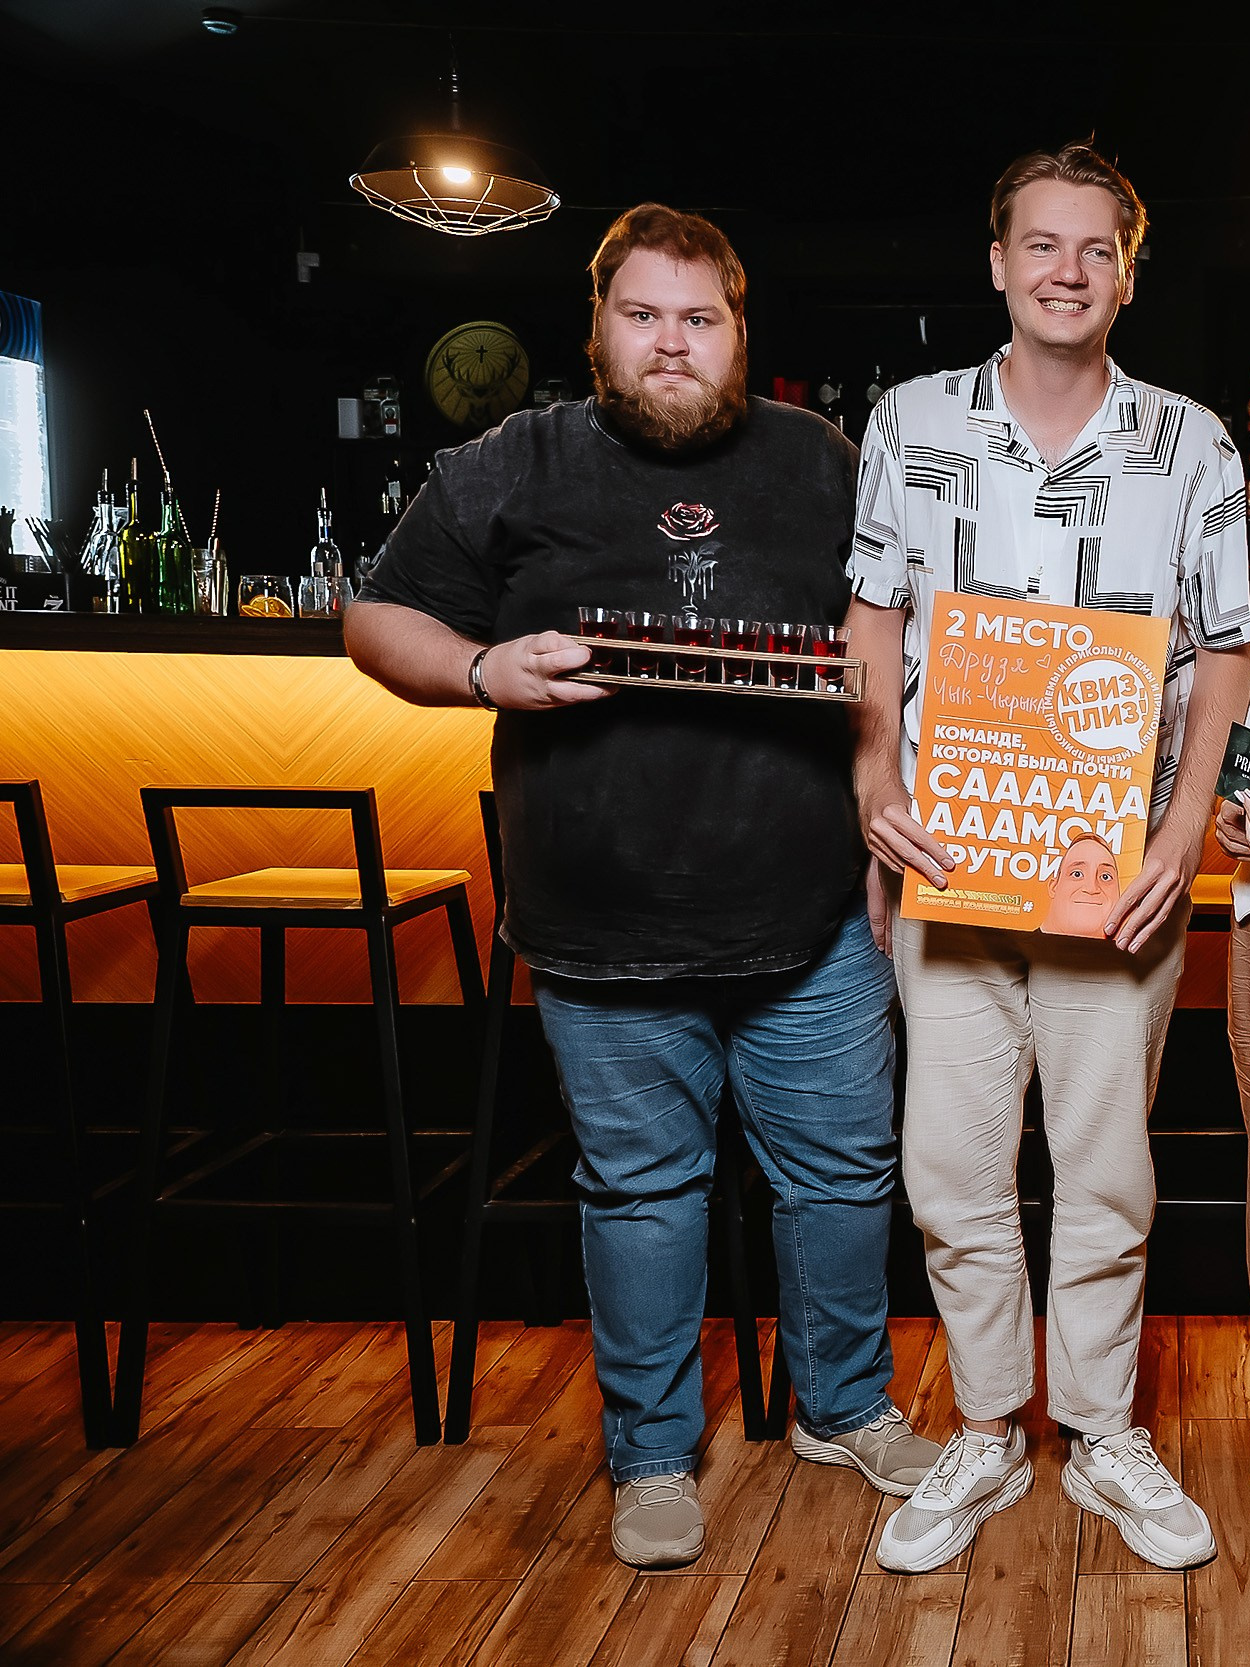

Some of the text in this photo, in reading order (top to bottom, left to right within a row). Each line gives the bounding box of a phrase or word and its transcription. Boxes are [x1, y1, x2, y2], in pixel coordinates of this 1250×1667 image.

[945, 609, 1094, 652] 2 МЕСТО
[934, 725, 1027, 751] КОМАНДЕ,
[932, 744, 1133, 781] КОТОРАЯ БЫЛА ПОЧТИ
[924, 842, 1063, 882] РУТОЙ
